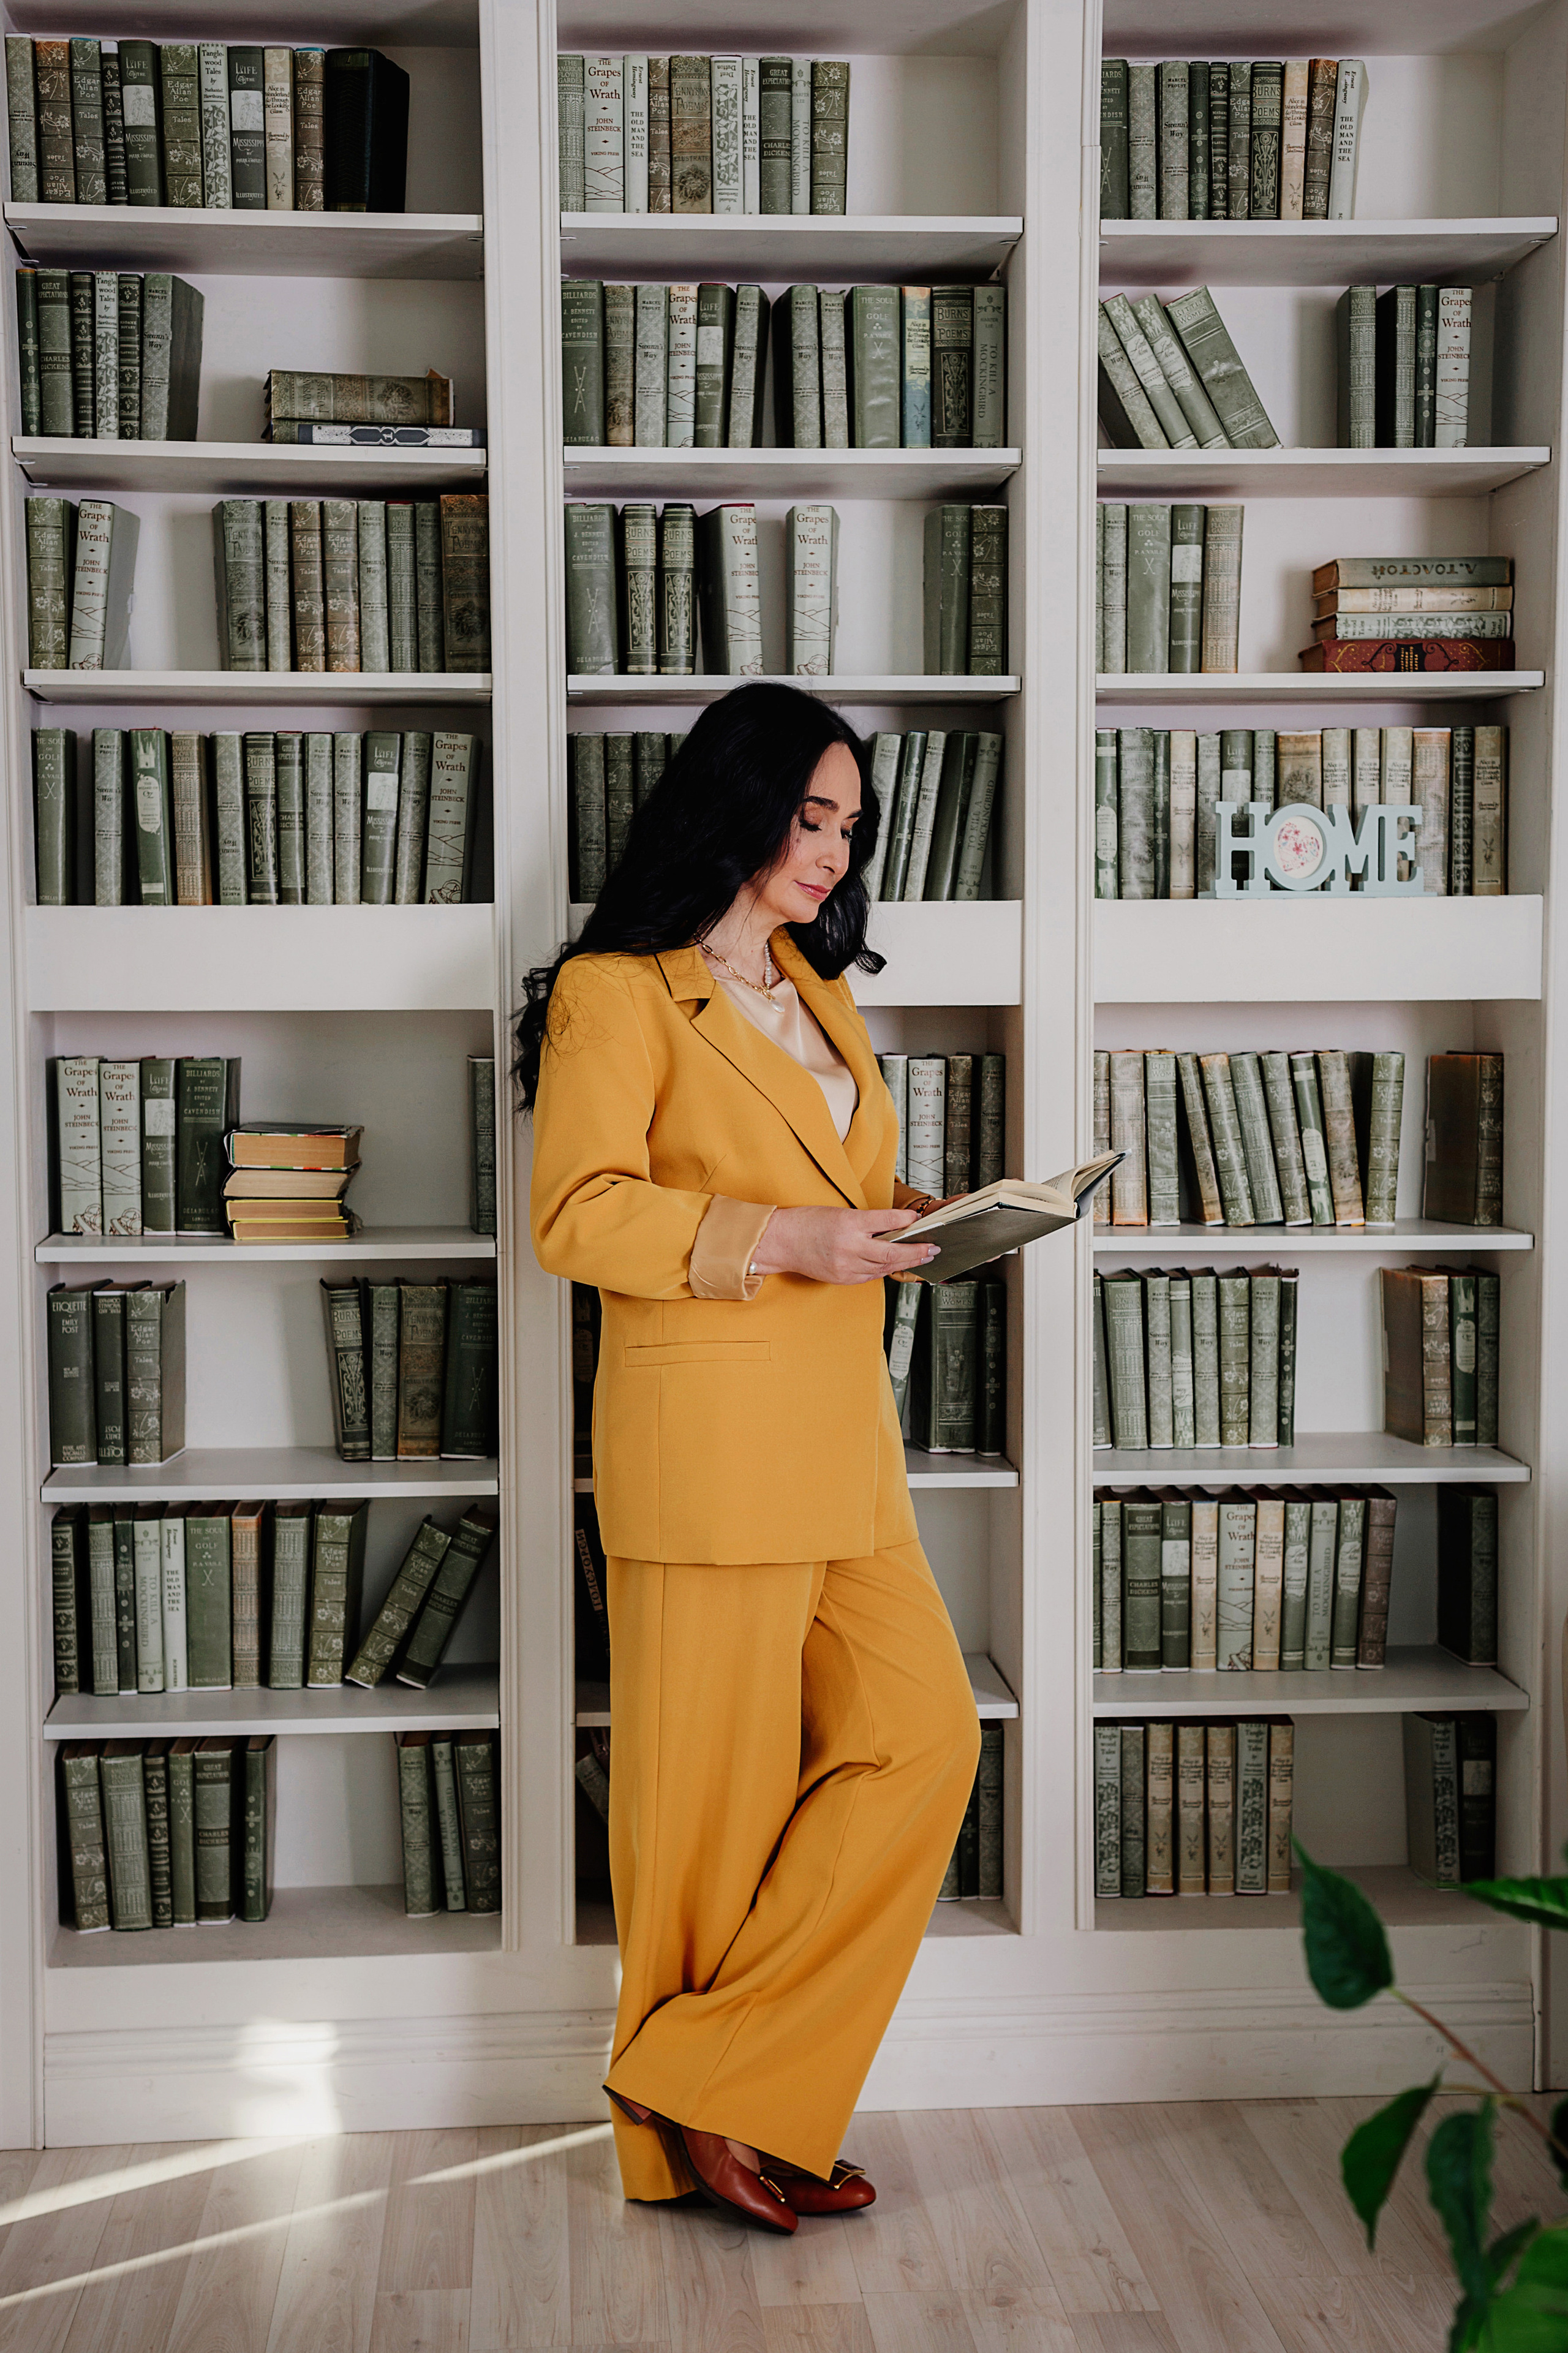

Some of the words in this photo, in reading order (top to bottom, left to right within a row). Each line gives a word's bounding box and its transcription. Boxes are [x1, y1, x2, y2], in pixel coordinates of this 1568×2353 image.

[589, 67, 621, 77] Grapes
[74, 76, 100, 85] Edgar
[590, 89, 620, 99] Wrath
[1169, 130, 1185, 138] Way
[669, 293, 697, 303] Grapes
[1442, 296, 1472, 308] Grapes
[670, 315, 696, 324] Wrath
[978, 344, 987, 418] MOCKINGBIRD
[80, 510, 110, 521] Grapes
[797, 514, 829, 524] Grapes
[80, 531, 109, 543] Wrath
[798, 535, 827, 545] Wrath
[435, 740, 467, 752] Grapes
[436, 761, 465, 772] Wrath
[978, 780, 994, 851] MOCKINGBIRD
[971, 810, 981, 833] KILL
[967, 835, 976, 850] TO
[1215, 801, 1423, 891] HOME
[912, 1067, 943, 1078] Grapes
[105, 1092, 135, 1101] Wrath
[913, 1087, 942, 1097] Wrath
[53, 1302, 86, 1313] ETIQUETTE
[1322, 1547, 1331, 1617] MOCKINGBIRD
